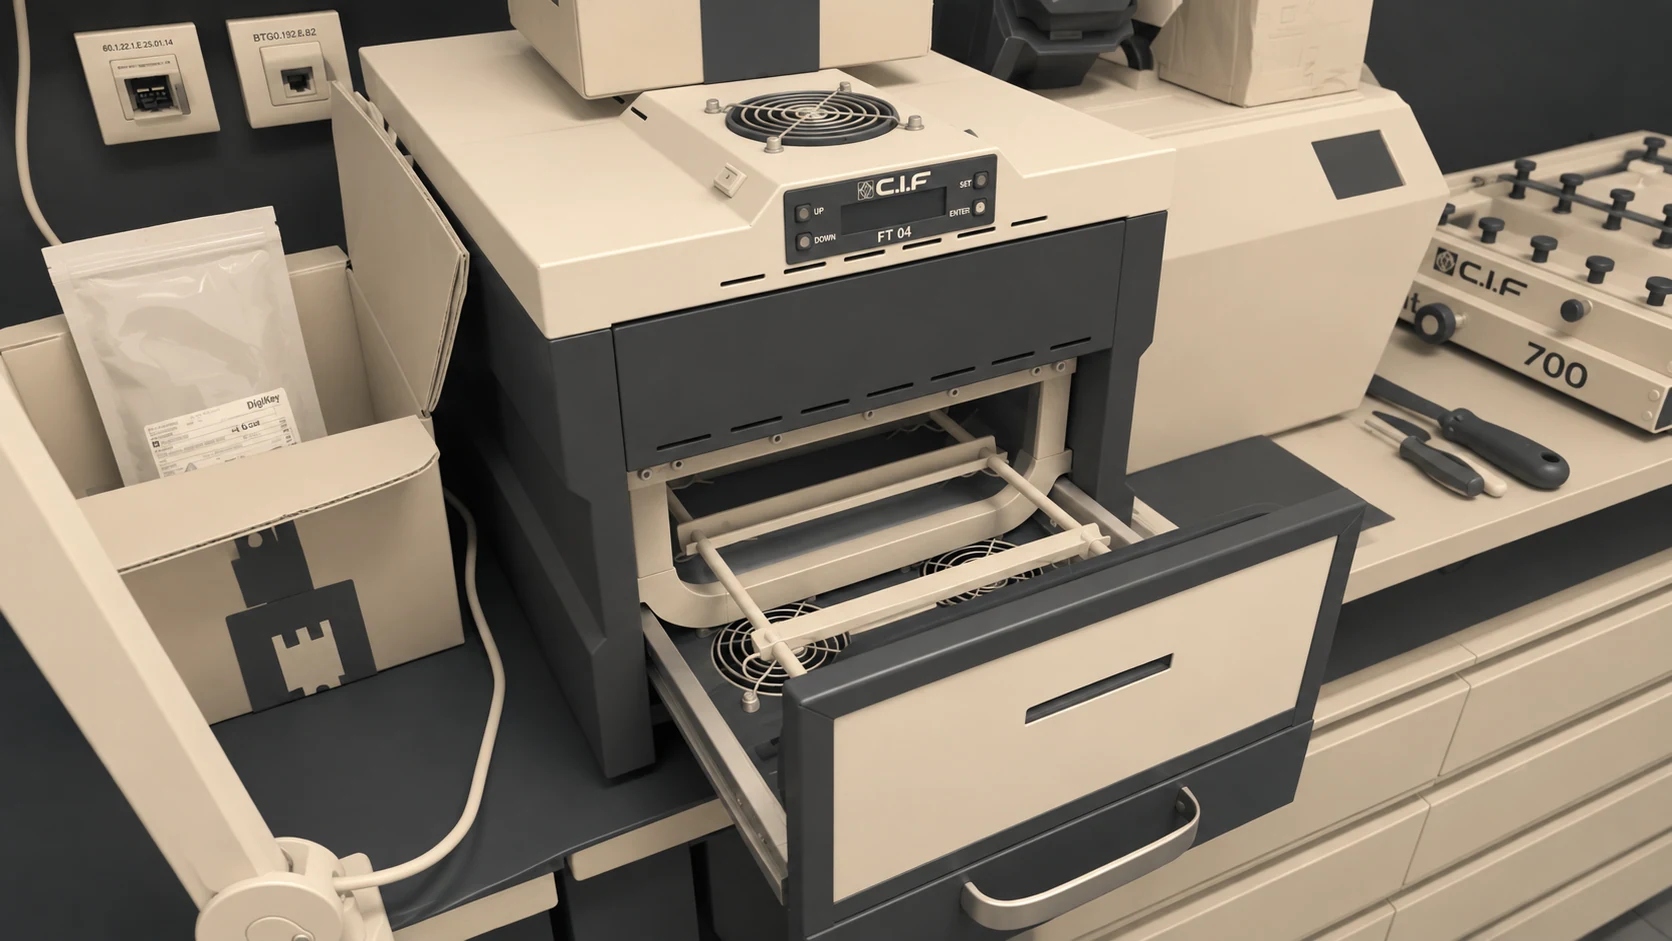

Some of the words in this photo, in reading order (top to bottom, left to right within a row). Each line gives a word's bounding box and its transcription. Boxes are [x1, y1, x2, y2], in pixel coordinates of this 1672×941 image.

[875, 171, 931, 196] C.I.F
[960, 179, 972, 189] SET
[813, 207, 825, 216] UP
[949, 207, 971, 217] ENTER
[814, 234, 836, 244] DOWN
[877, 229, 894, 243] FT
[897, 225, 912, 239] 04
[1459, 260, 1528, 296] C.I.F
[1524, 341, 1588, 389] 700
